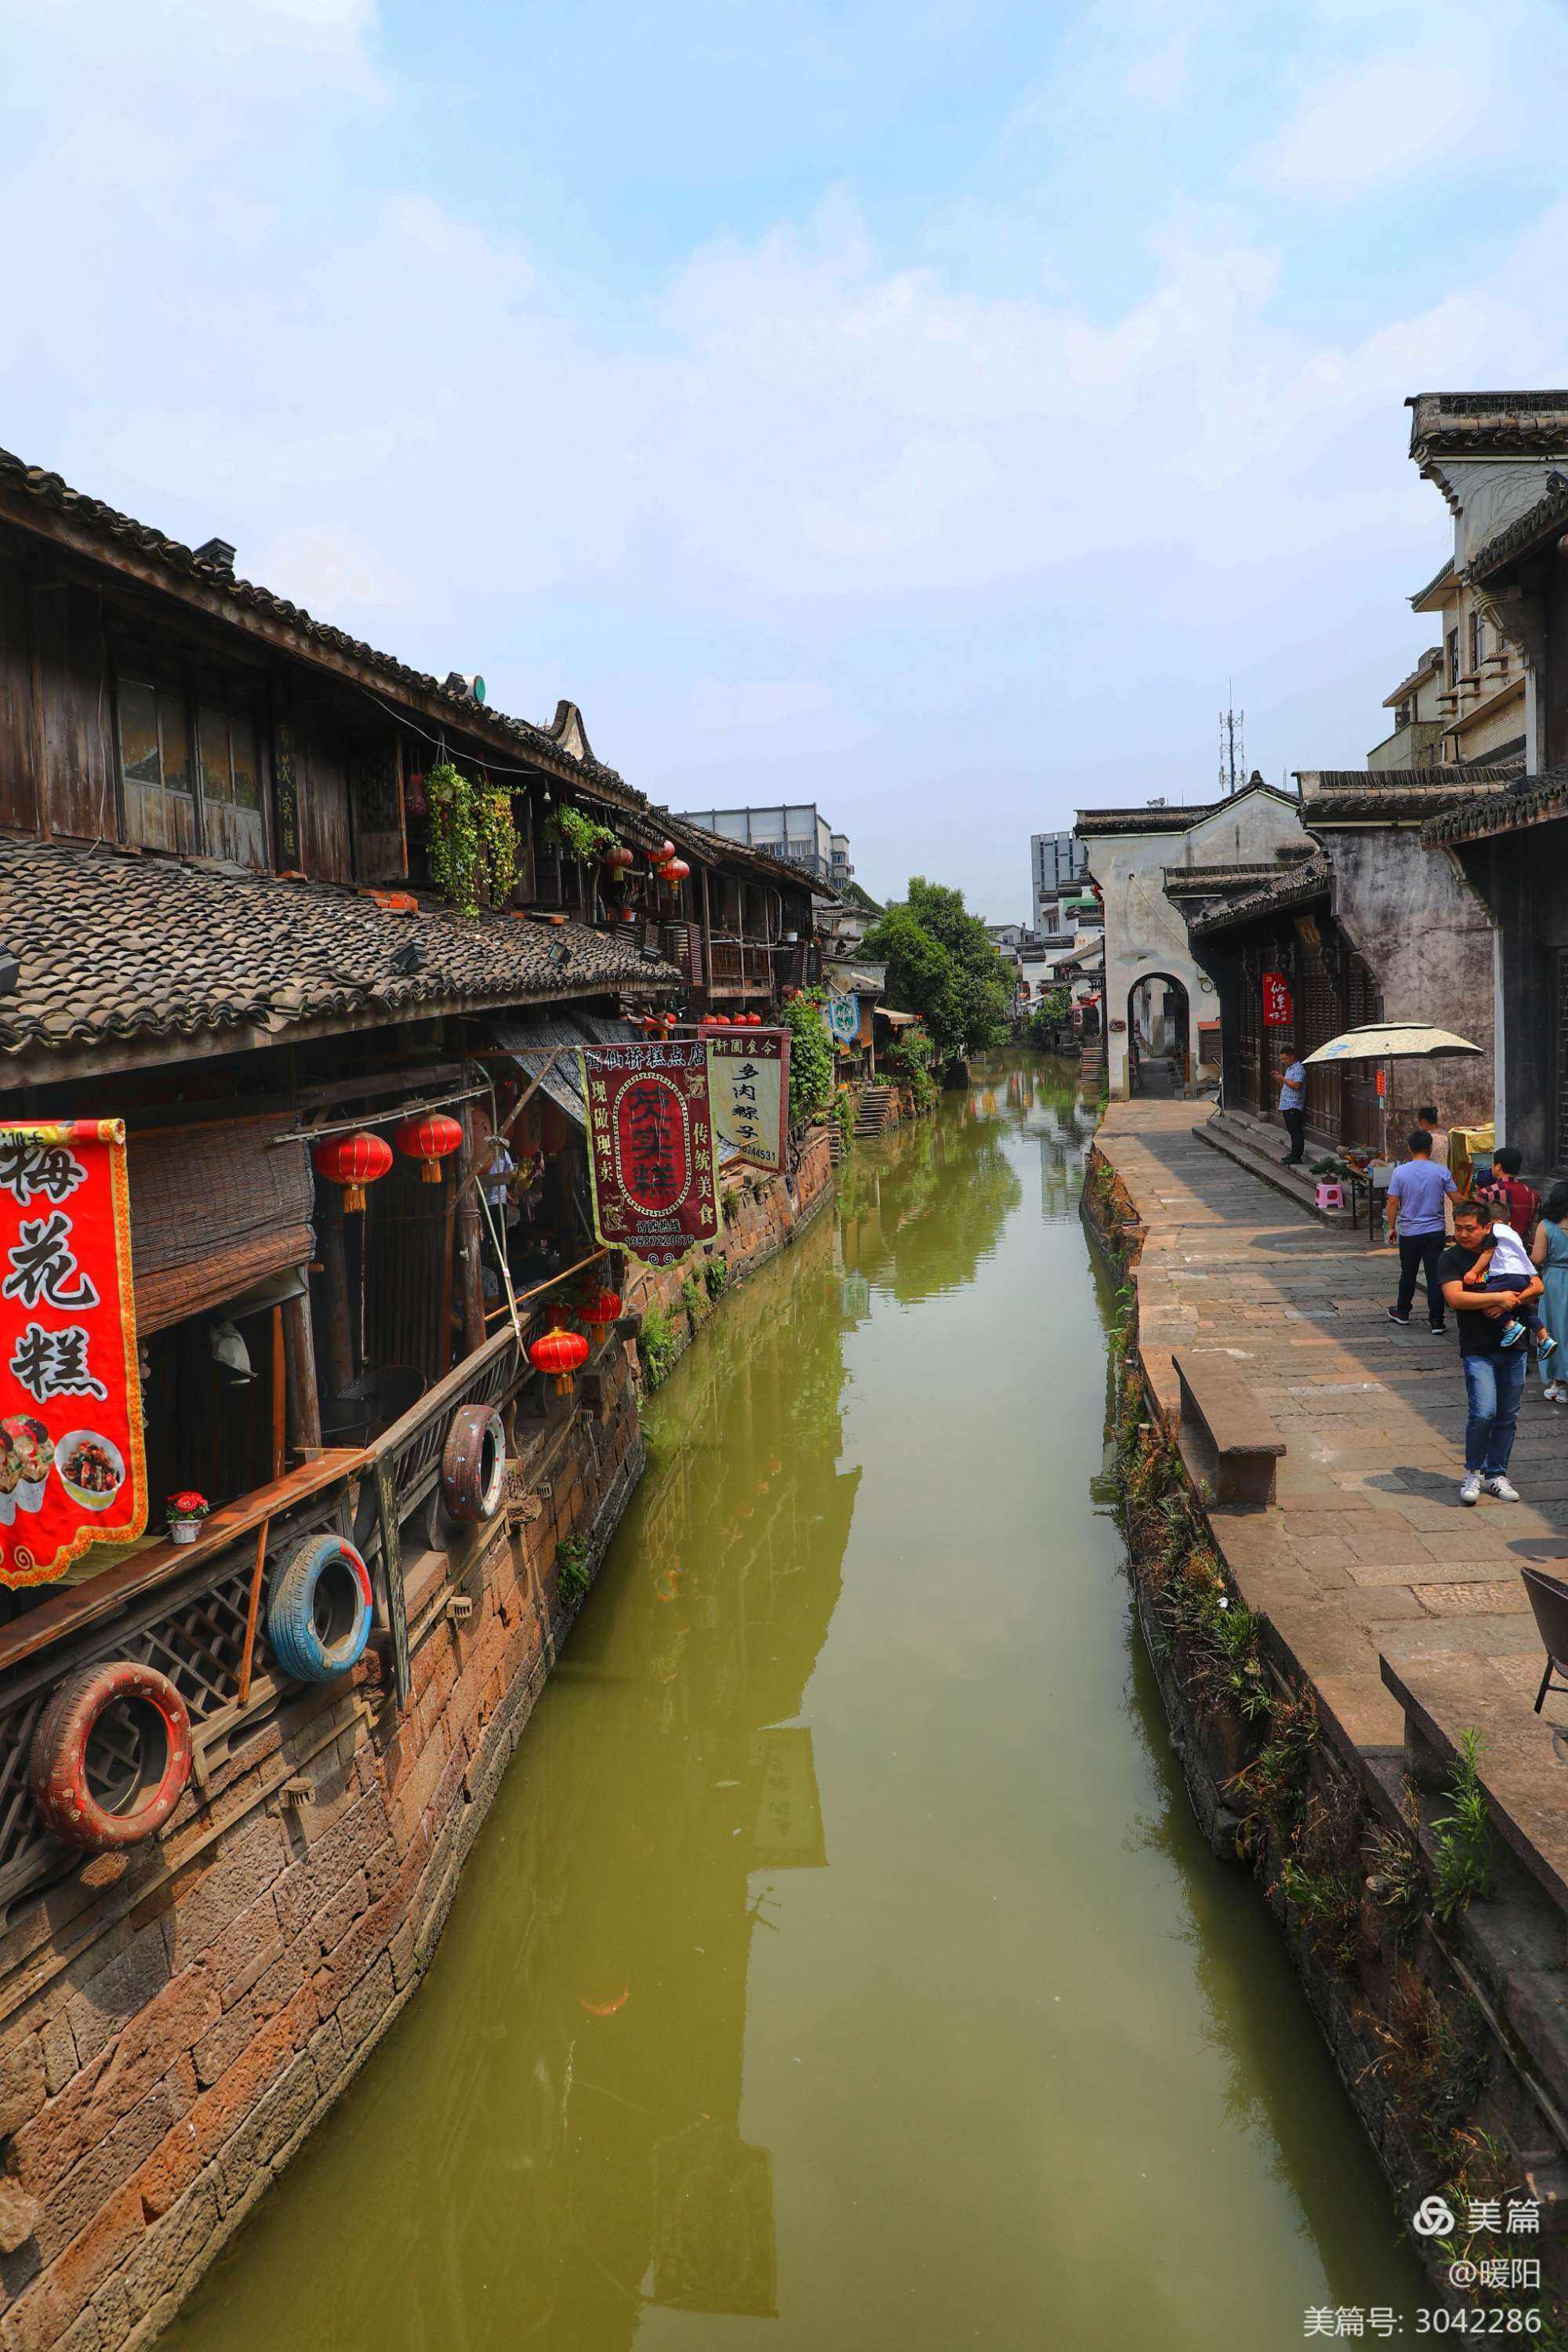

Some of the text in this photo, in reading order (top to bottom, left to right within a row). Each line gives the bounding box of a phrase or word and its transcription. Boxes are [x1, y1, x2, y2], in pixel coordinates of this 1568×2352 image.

[590, 1080, 613, 1183] 现做现卖
[629, 1087, 677, 1198] 芡实糕
[731, 1063, 760, 1139] 多肉粽子
[636, 1218, 681, 1233] 订购热线
[692, 1122, 714, 1226] 传统美食
[0, 1145, 107, 1401] 梅花糕
